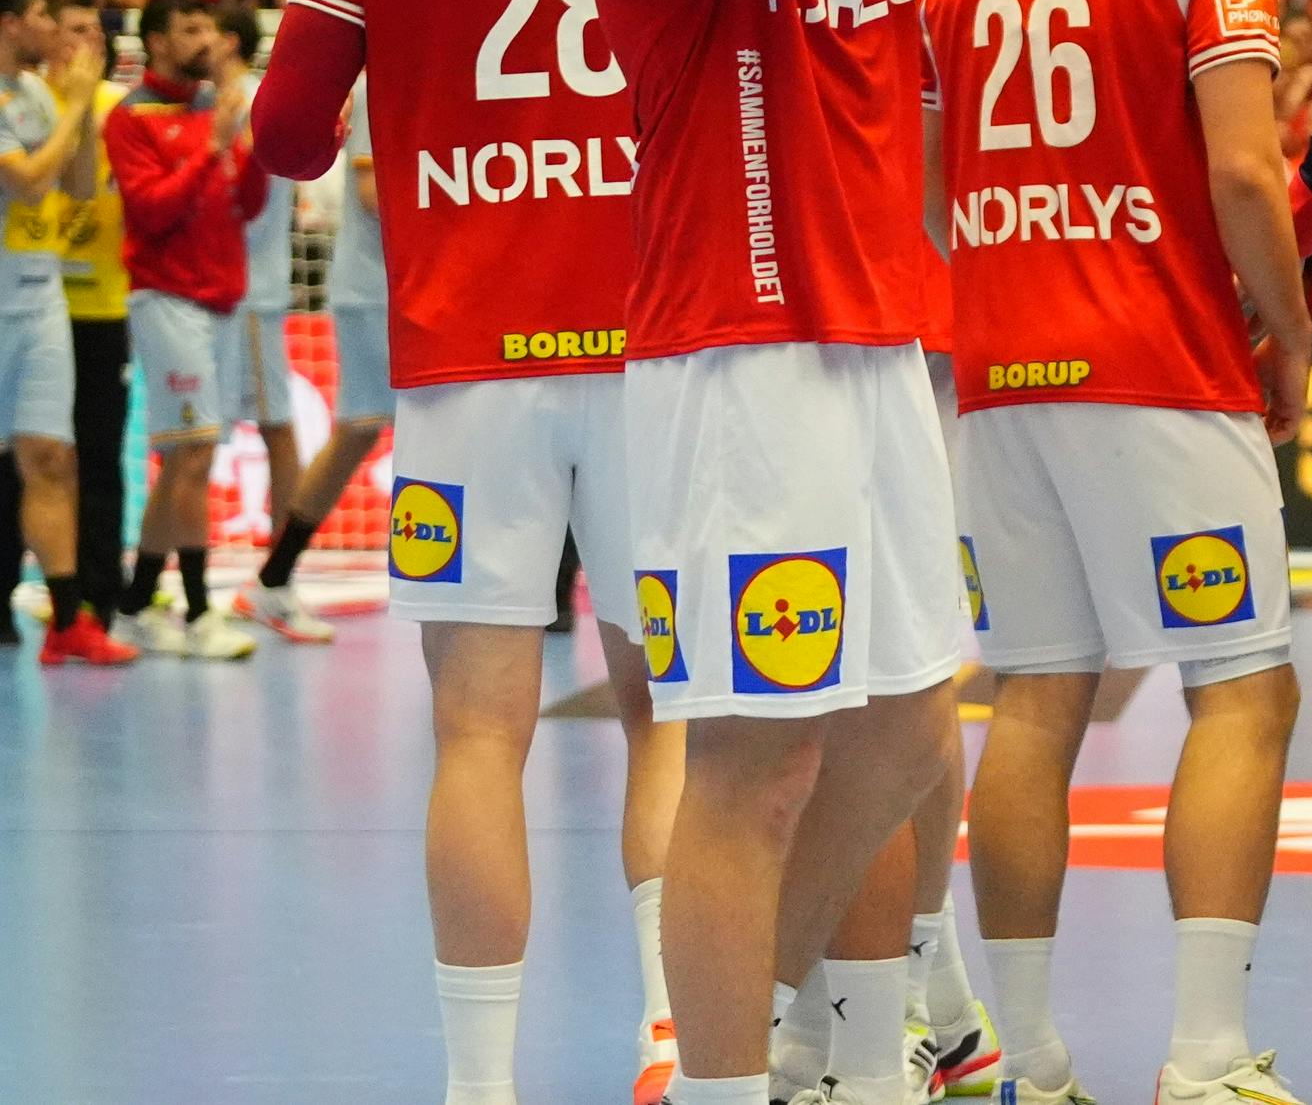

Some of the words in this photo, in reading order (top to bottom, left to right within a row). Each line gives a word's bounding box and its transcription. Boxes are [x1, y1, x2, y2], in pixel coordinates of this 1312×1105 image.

[736, 48, 785, 305] #SAMMENFORHOLDET
[952, 183, 1163, 251] NORLYS
[987, 359, 1091, 391] BORUP
